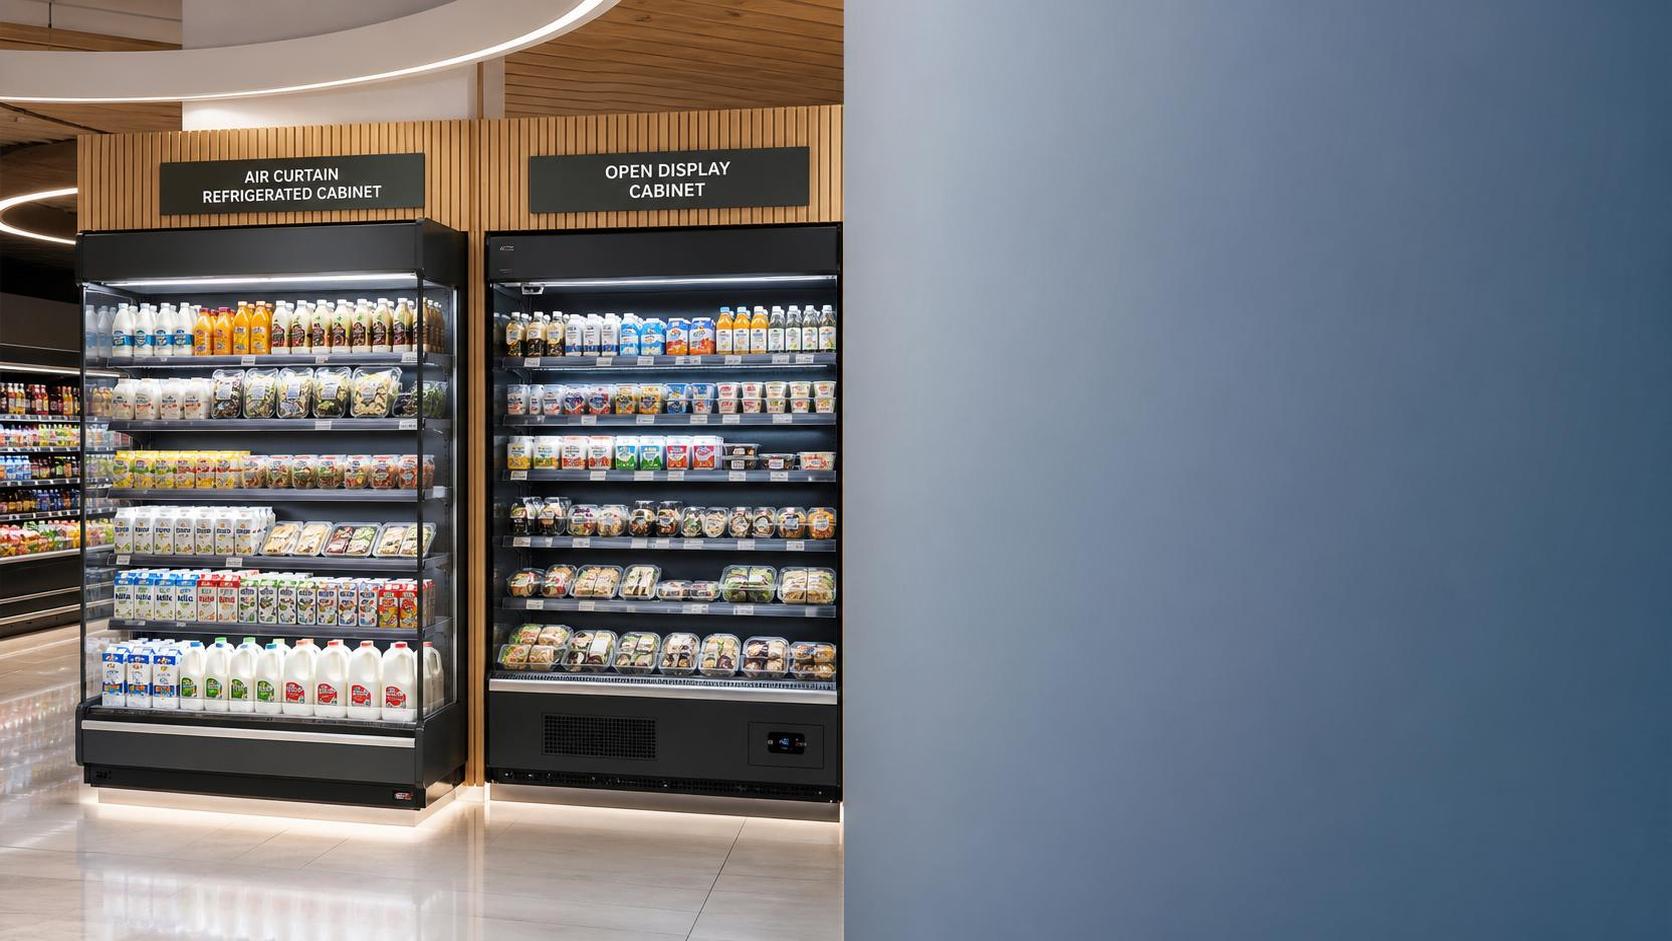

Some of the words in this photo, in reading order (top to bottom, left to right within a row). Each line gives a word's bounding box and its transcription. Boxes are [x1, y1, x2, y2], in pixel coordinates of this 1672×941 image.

[245, 170, 269, 184] AIR
[274, 168, 339, 183] CURTAIN
[605, 164, 653, 180] OPEN
[658, 162, 731, 178] DISPLAY
[202, 188, 313, 204] REFRIGERATED
[316, 185, 383, 200] CABINET
[629, 183, 706, 199] CABINET
